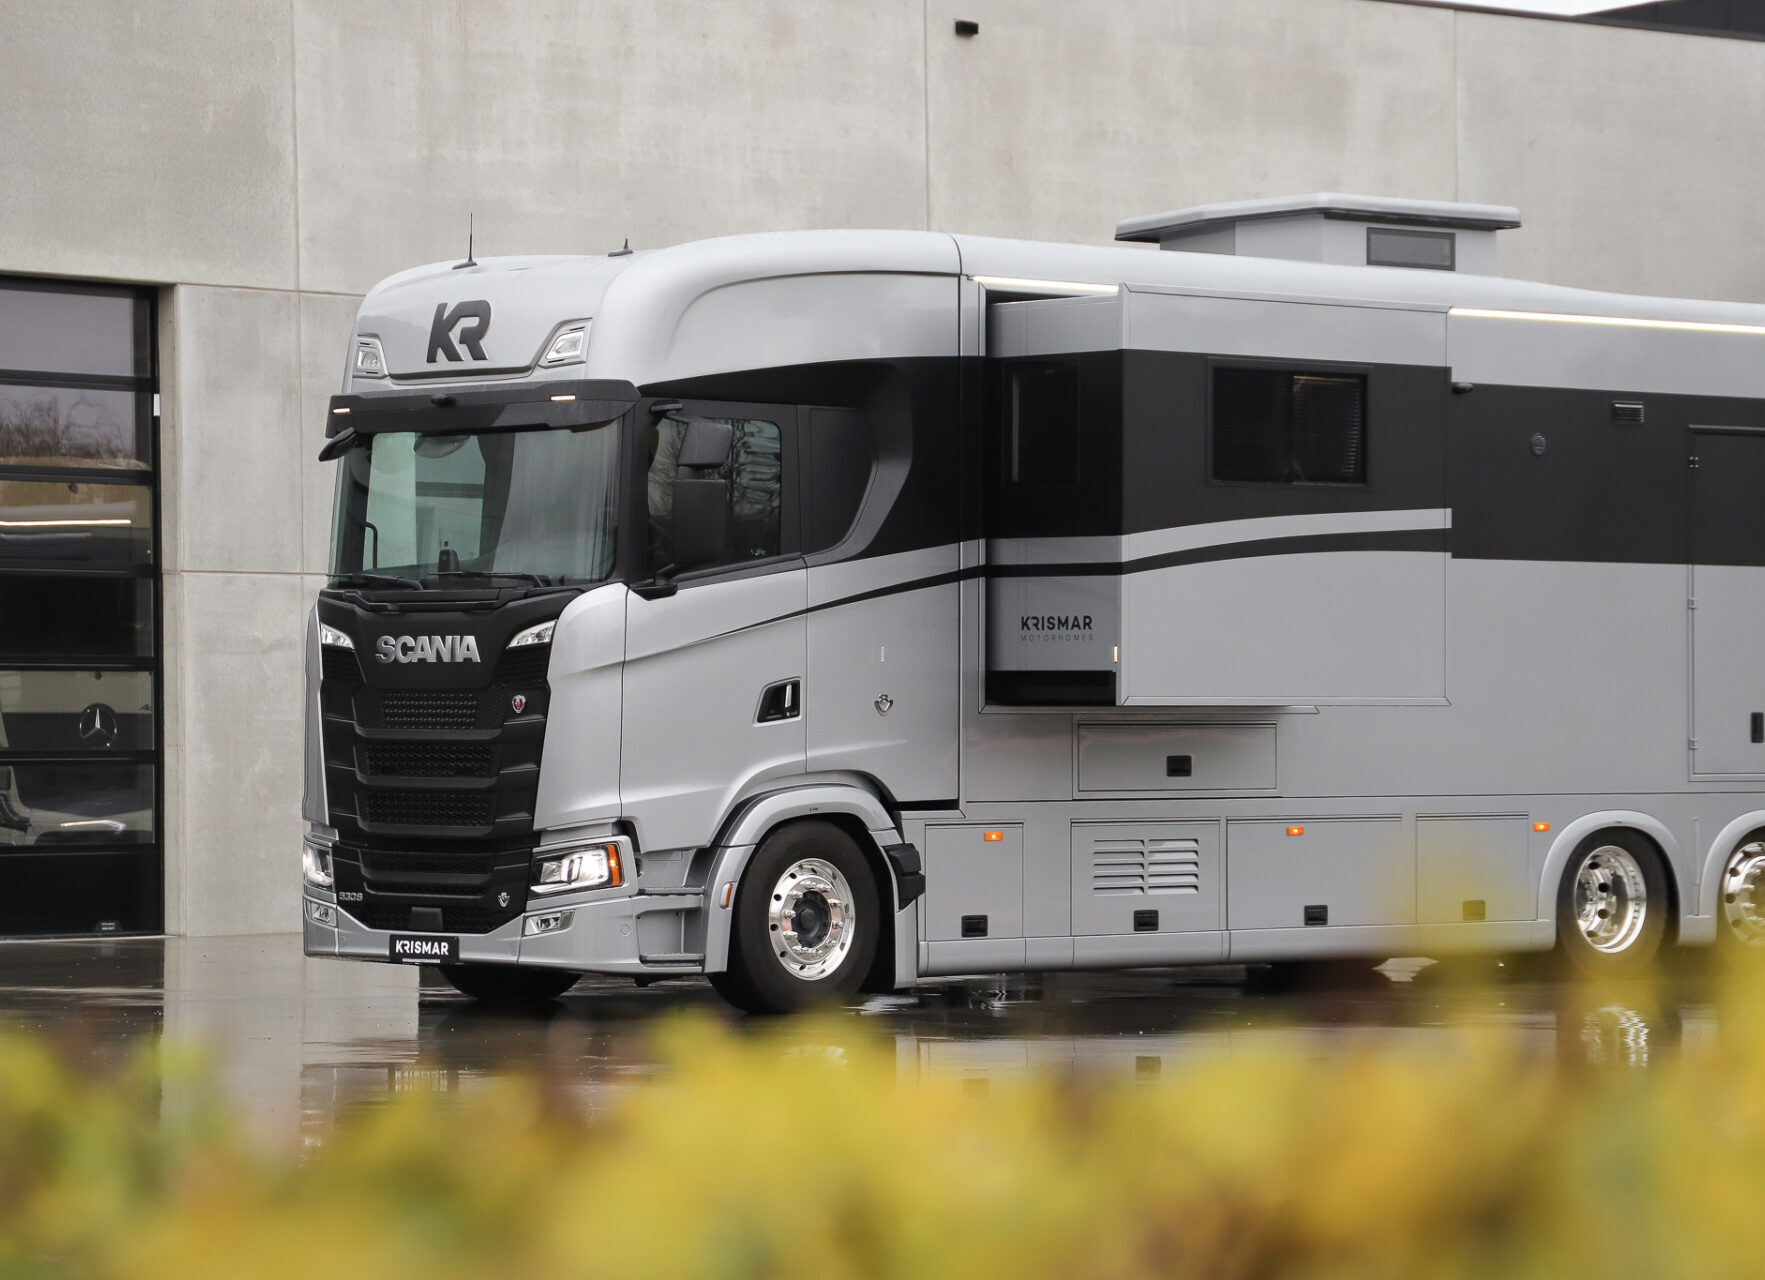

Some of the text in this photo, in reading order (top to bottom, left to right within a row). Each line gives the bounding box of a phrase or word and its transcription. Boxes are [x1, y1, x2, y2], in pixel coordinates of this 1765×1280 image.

[426, 300, 491, 363] KR
[1021, 616, 1093, 631] KRISMAR
[375, 635, 481, 664] SCANIA
[395, 940, 449, 955] KRISMAR
